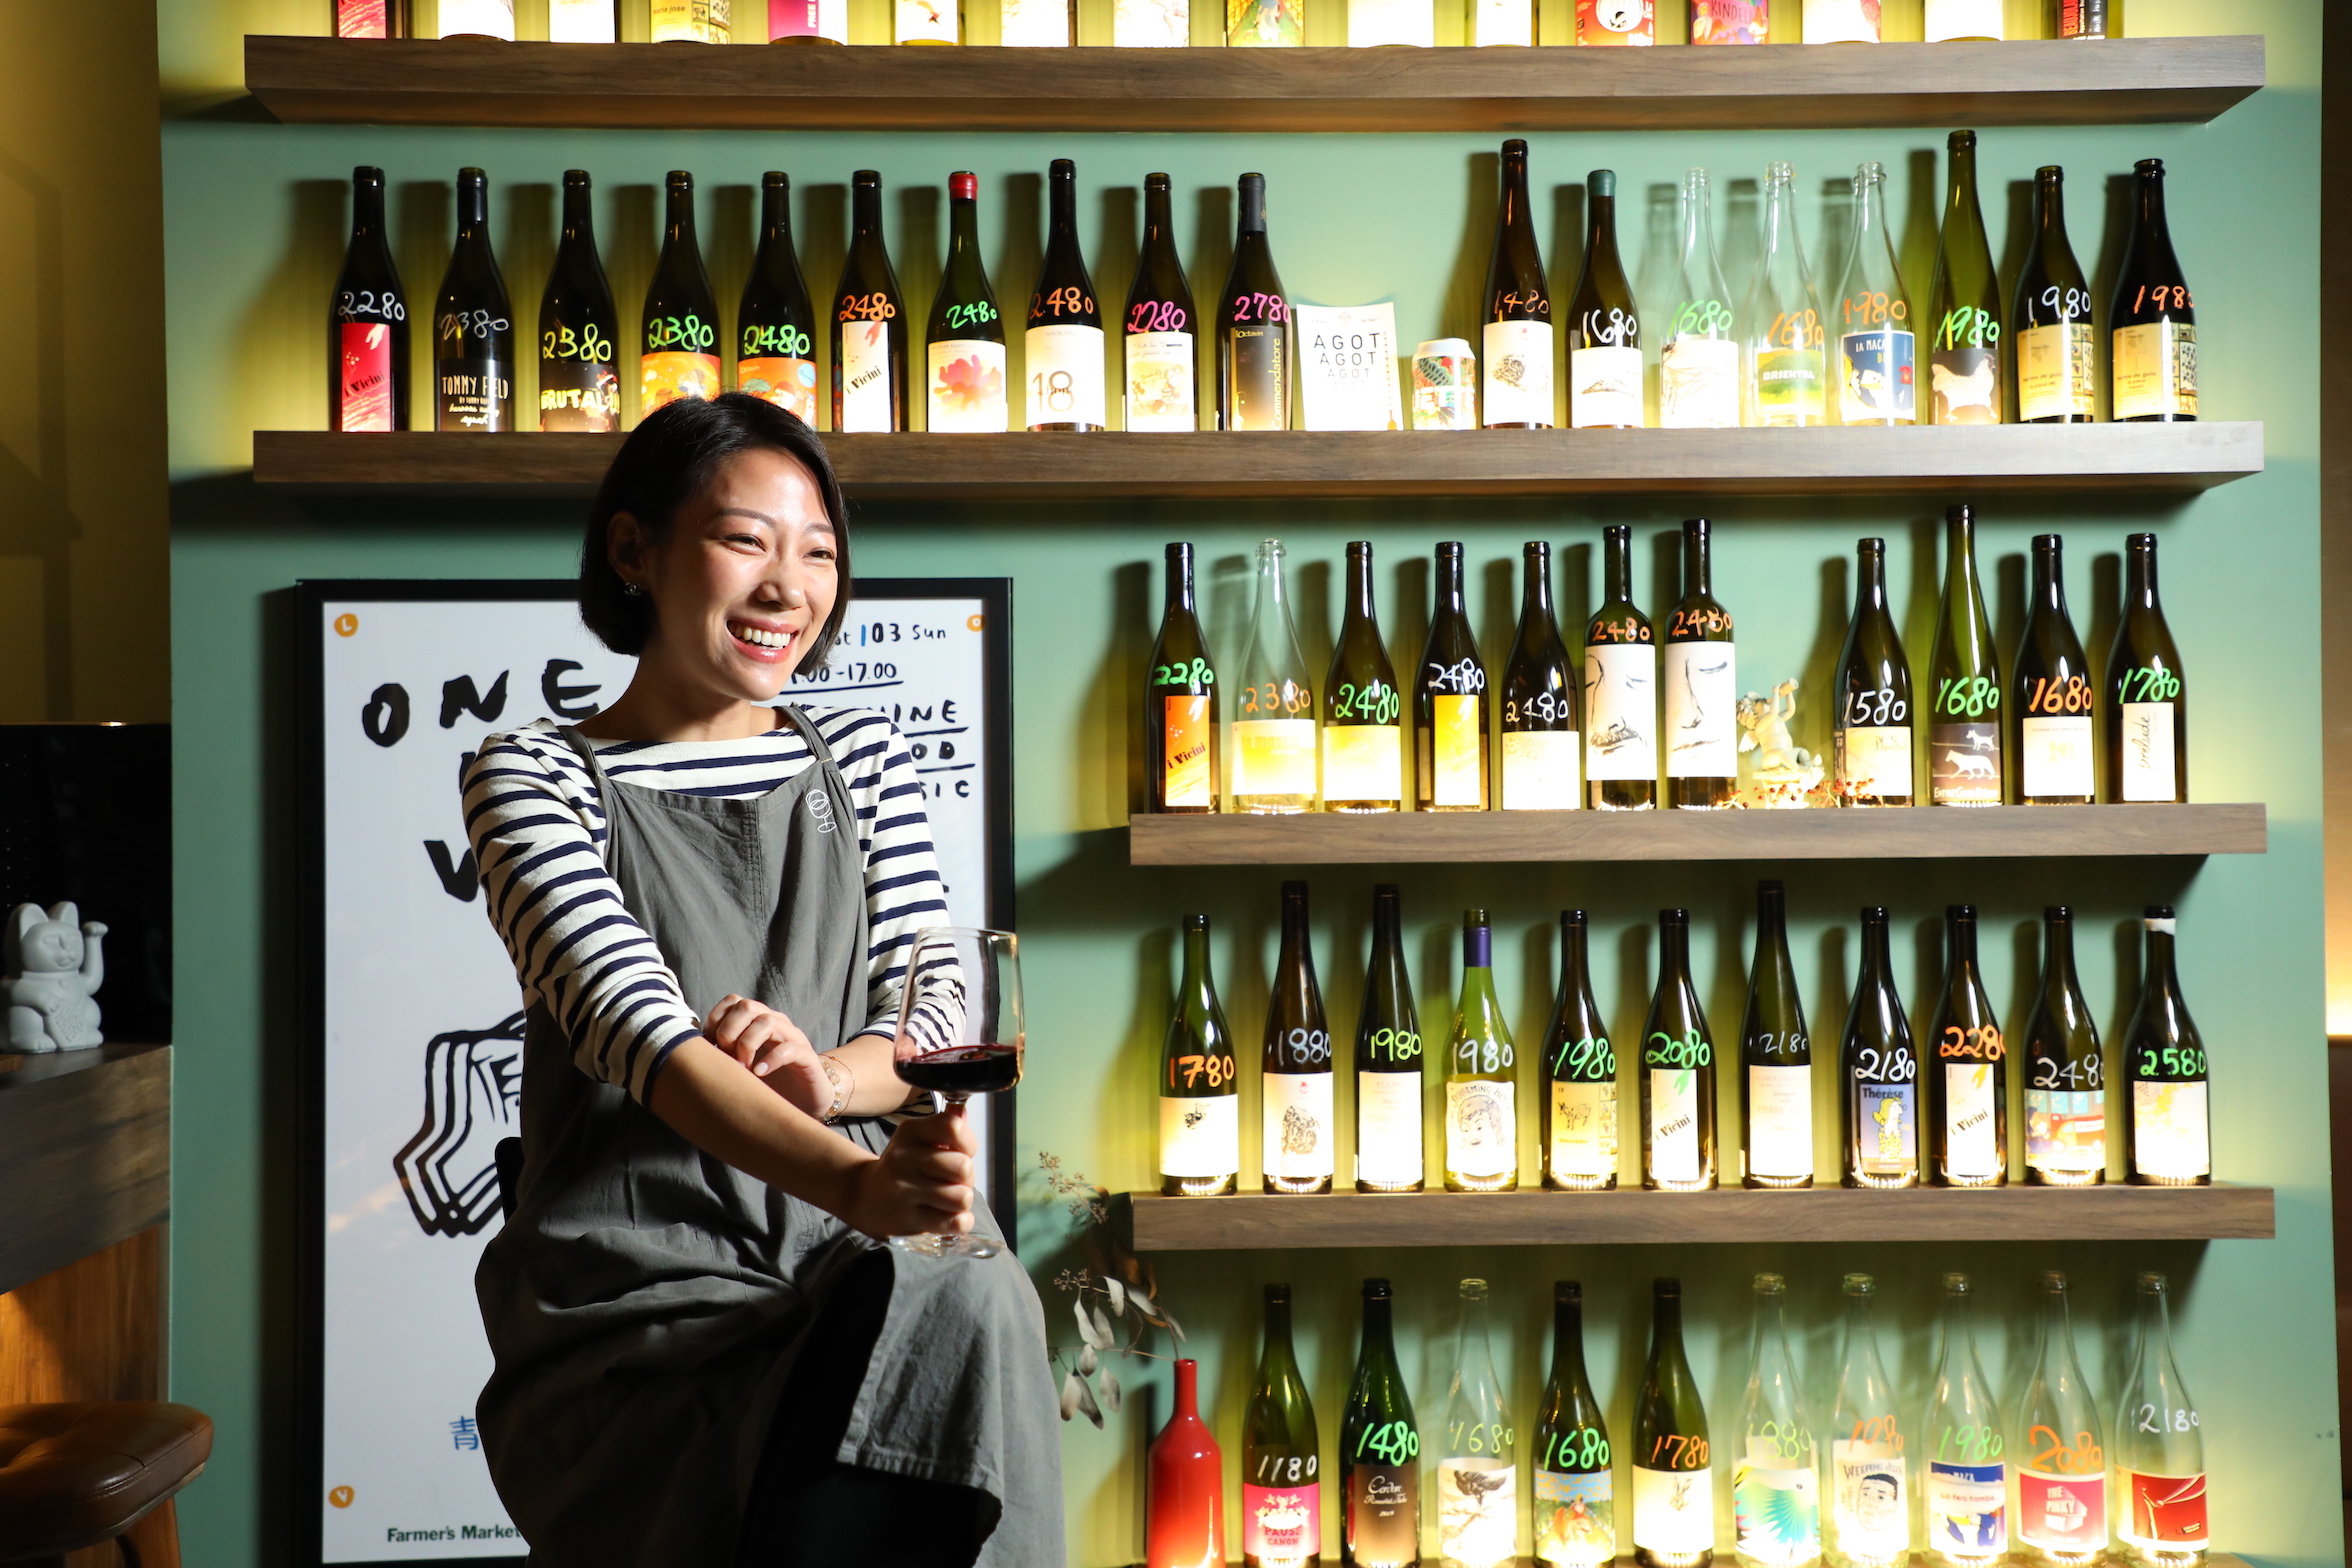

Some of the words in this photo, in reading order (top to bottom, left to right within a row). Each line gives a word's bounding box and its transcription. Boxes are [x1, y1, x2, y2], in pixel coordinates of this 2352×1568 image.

[338, 291, 405, 321] 2280
[839, 292, 896, 322] 2480
[946, 300, 997, 330] 2480
[1030, 286, 1094, 319] 2480
[1234, 292, 1291, 323] 2780
[1493, 290, 1549, 314] 1480
[1669, 299, 1733, 337] 1680
[1844, 291, 1906, 325] 1980
[2029, 285, 2091, 323] 1980
[543, 323, 612, 362] 2380
[648, 314, 714, 351] 2380
[743, 324, 811, 355] 2480
[1314, 333, 1380, 350] AGOT
[1582, 307, 1637, 348] 1680
[1935, 305, 2000, 348] 1980
[1320, 352, 1376, 366] AGOT
[1856, 342, 1864, 352] LA
[442, 375, 477, 395] TOMMY
[482, 376, 509, 399] FELD
[850, 365, 883, 390] Vicini
[1268, 338, 1282, 430] Commendatore
[872, 622, 901, 643] 03
[912, 624, 947, 640] Sun
[1592, 616, 1650, 642] 2480
[1671, 608, 1733, 638] 2480
[1153, 657, 1214, 687] 2280
[1428, 657, 1485, 692] 2480
[2119, 666, 2180, 705] 1780
[362, 659, 602, 747] ONE
[1336, 683, 1399, 725] 2480
[1505, 691, 1569, 723] 2480
[1844, 688, 1907, 726] 1580
[1935, 676, 2000, 717] 1680
[2029, 676, 2093, 714] 1680
[1174, 741, 1207, 765] Vicini
[1278, 1028, 1332, 1066] 1880
[1370, 1027, 1423, 1062] 1980
[1452, 1039, 1514, 1075] 1980
[1553, 1037, 1616, 1080] 1980
[1646, 1027, 1710, 1069] 2080
[1759, 1033, 1809, 1054] 2180
[1170, 1054, 1235, 1089] 1780
[1855, 1047, 1915, 1083] 2180
[2140, 1048, 2207, 1077] 2580
[1863, 1087, 1904, 1099] Thérèse
[1661, 1114, 1691, 1139] Vicini
[1957, 1109, 1988, 1131] Vicini
[2139, 1404, 2199, 1434] 2180
[1356, 1420, 1419, 1467] 1480
[1451, 1423, 1514, 1454] 1680
[1544, 1427, 1610, 1471] 1680
[1651, 1435, 1709, 1470] 1780
[1938, 1426, 2003, 1461] 1980
[2029, 1424, 2103, 1475] 2080
[1258, 1454, 1318, 1482] 1180
[2047, 1486, 2063, 1499] THE
[387, 1526, 456, 1542] Farmer's
[1267, 1537, 1298, 1546] CANON
